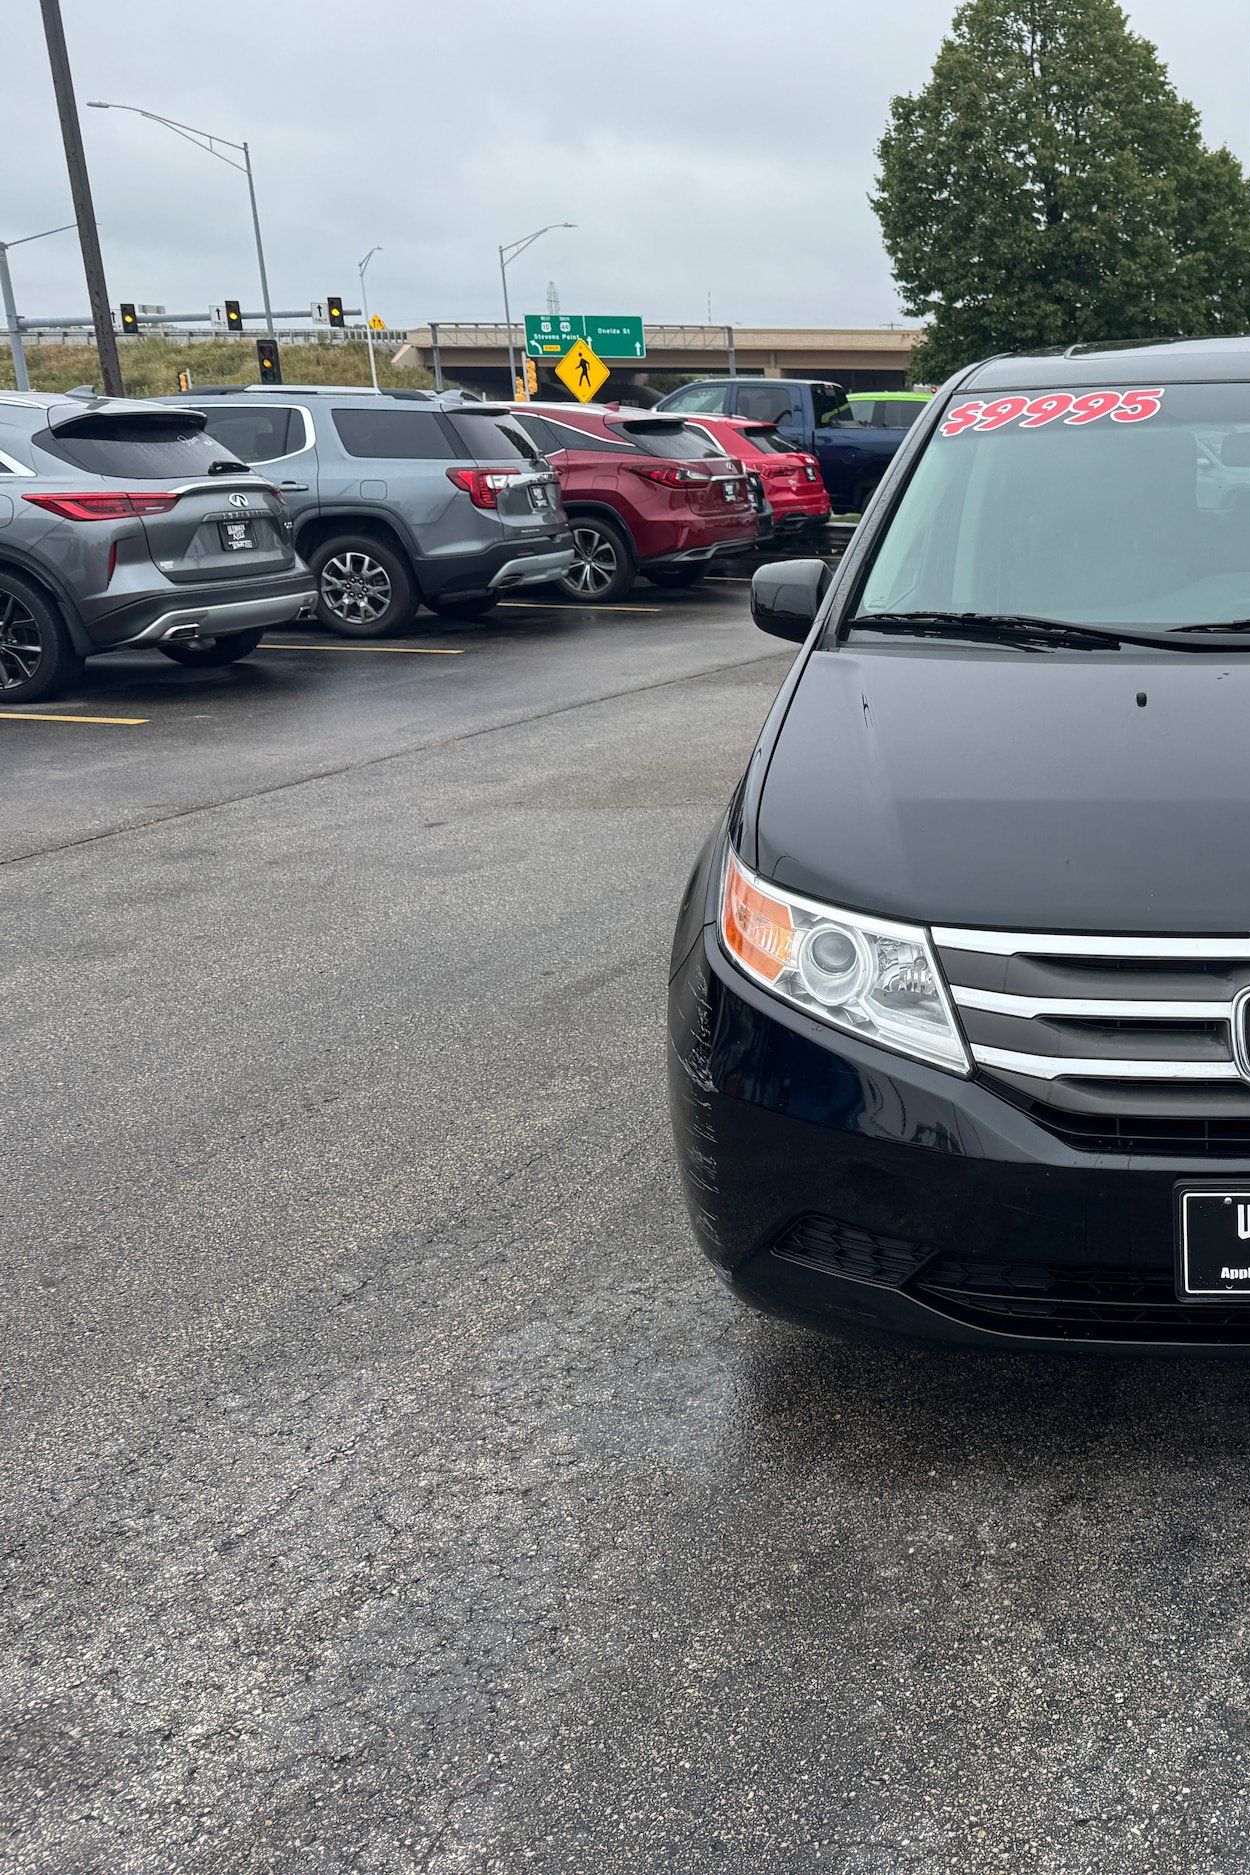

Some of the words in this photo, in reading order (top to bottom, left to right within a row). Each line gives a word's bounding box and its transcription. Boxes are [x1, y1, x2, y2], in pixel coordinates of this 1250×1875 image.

[597, 327, 620, 335] Oneida
[622, 327, 631, 335] St
[939, 388, 1165, 437] $9995
